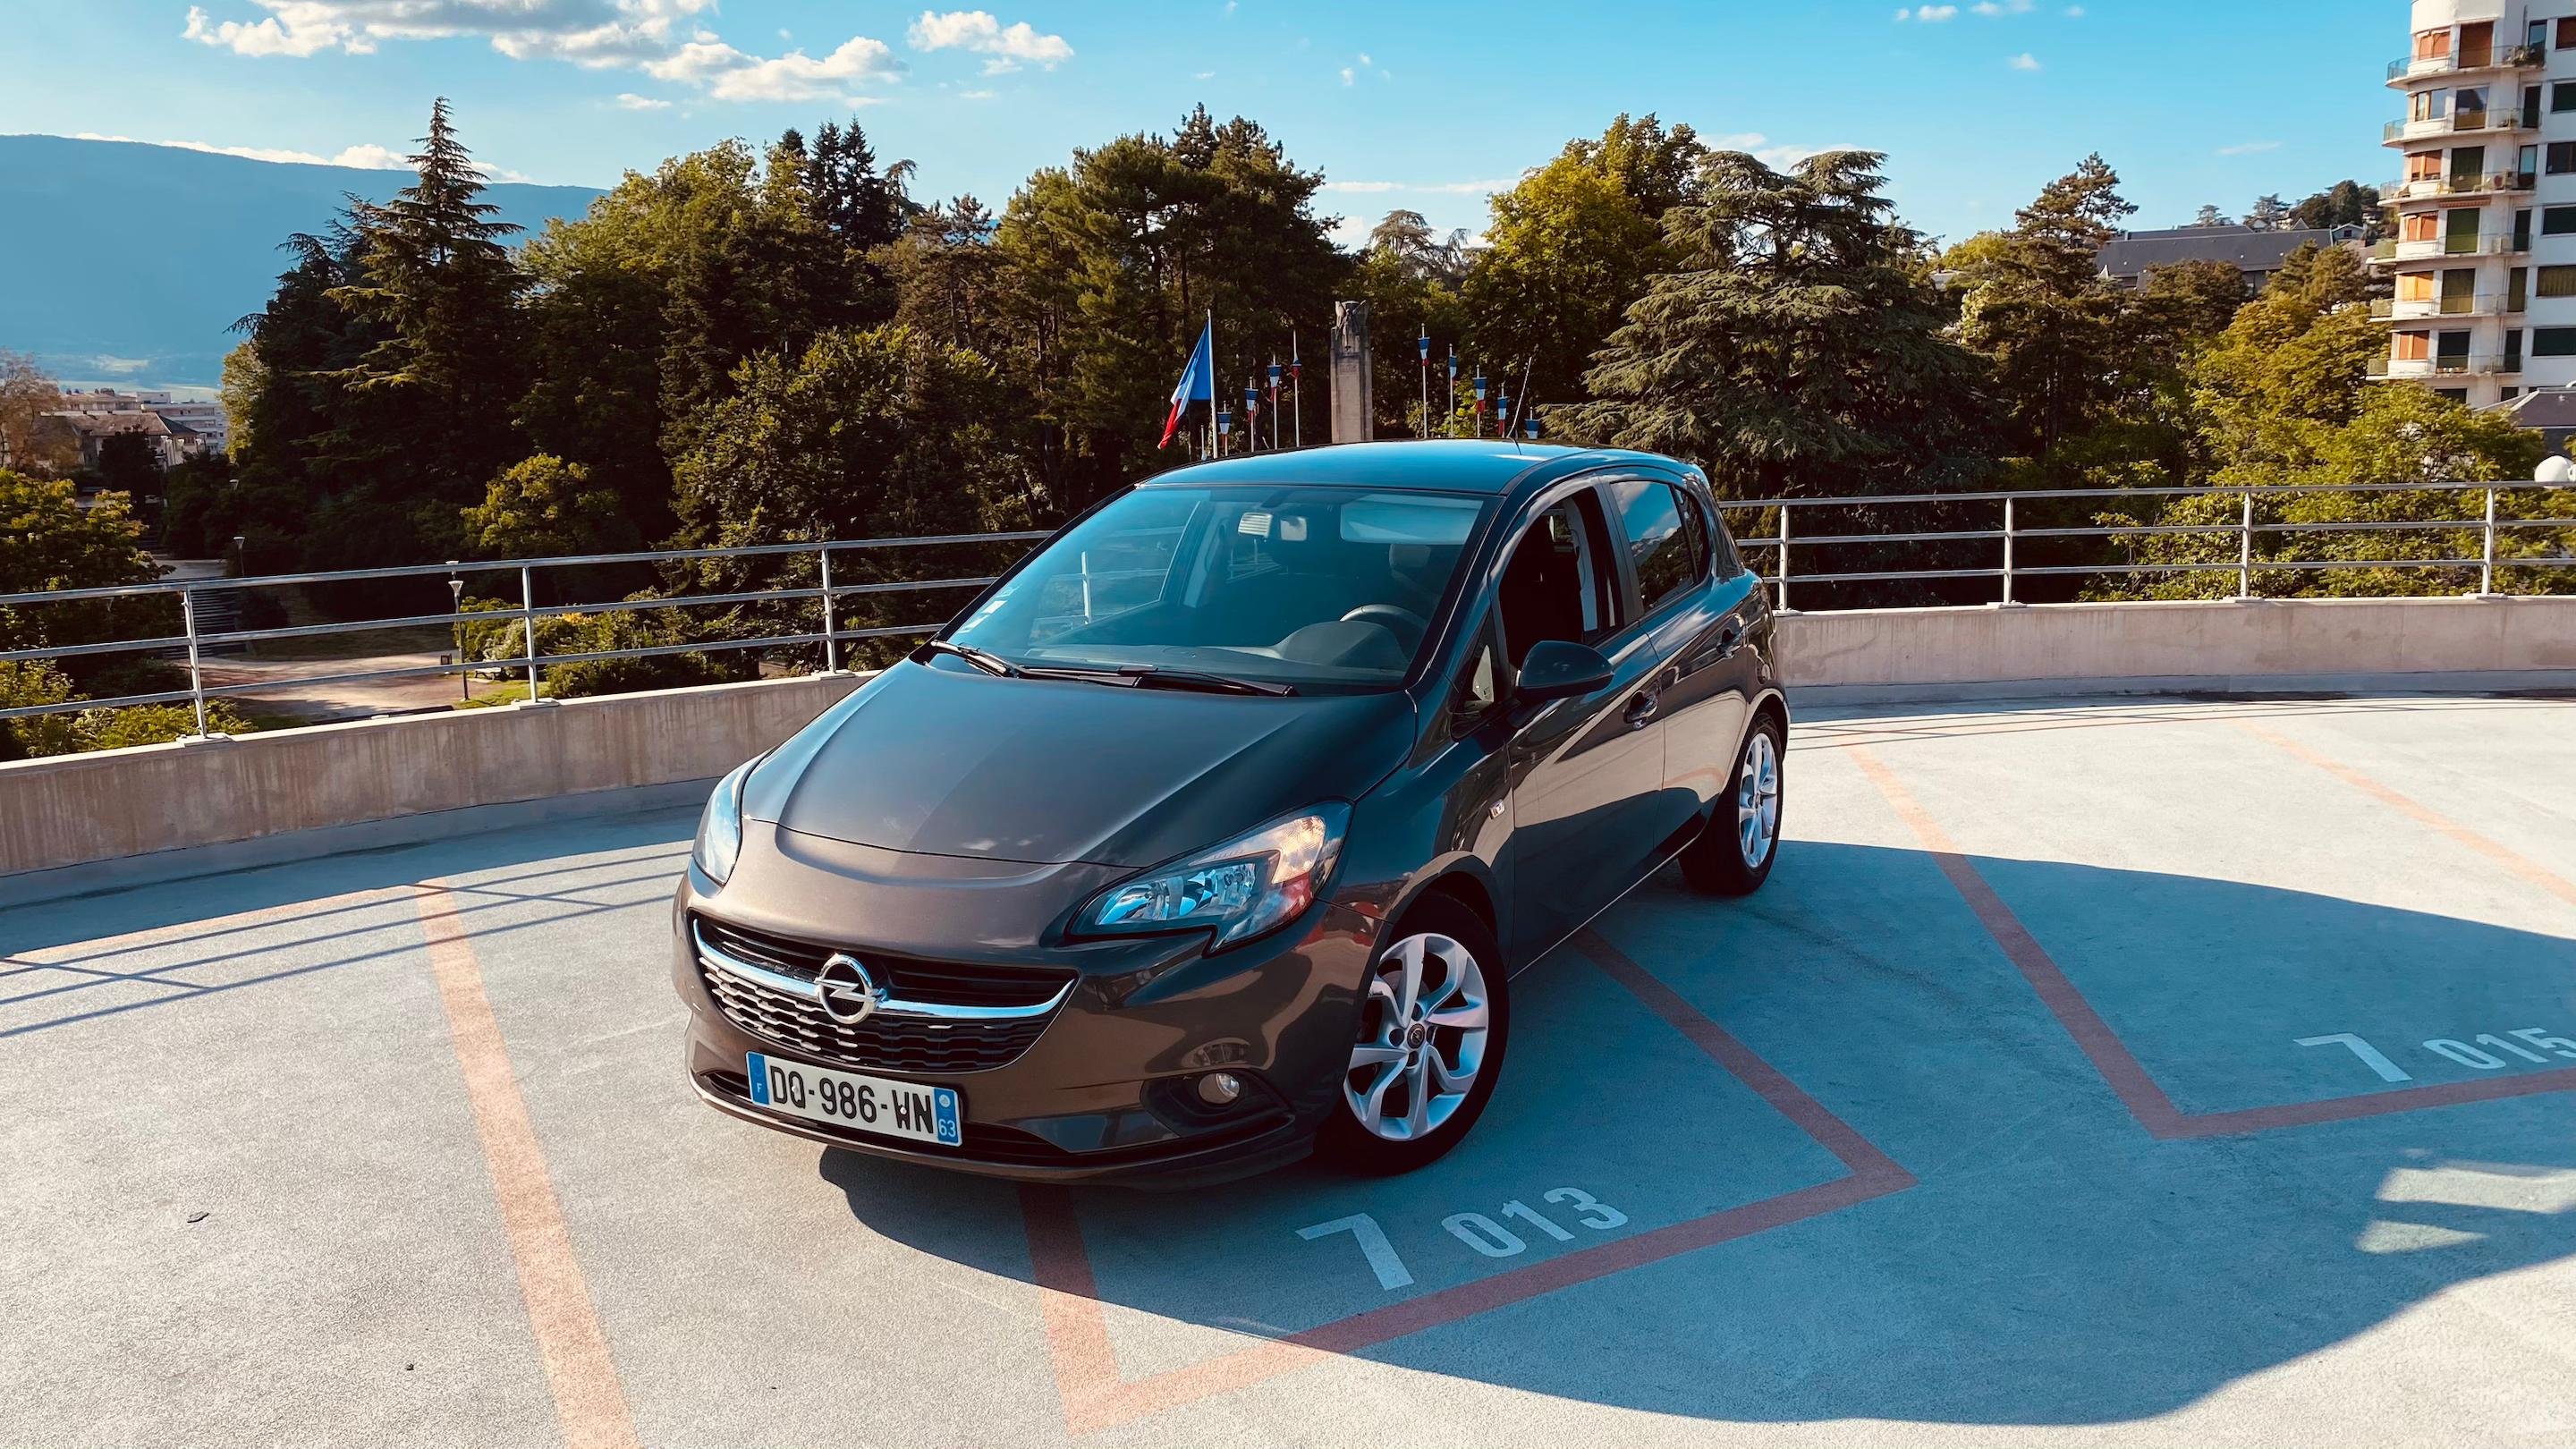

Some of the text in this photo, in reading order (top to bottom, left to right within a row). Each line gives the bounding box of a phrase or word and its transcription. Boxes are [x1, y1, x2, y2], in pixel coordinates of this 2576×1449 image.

[2292, 1027, 2576, 1082] 7 015
[756, 1082, 763, 1094] F
[769, 1065, 934, 1133] DQ-986-WN
[938, 1118, 956, 1138] 63
[1295, 1187, 1628, 1290] 7 013
